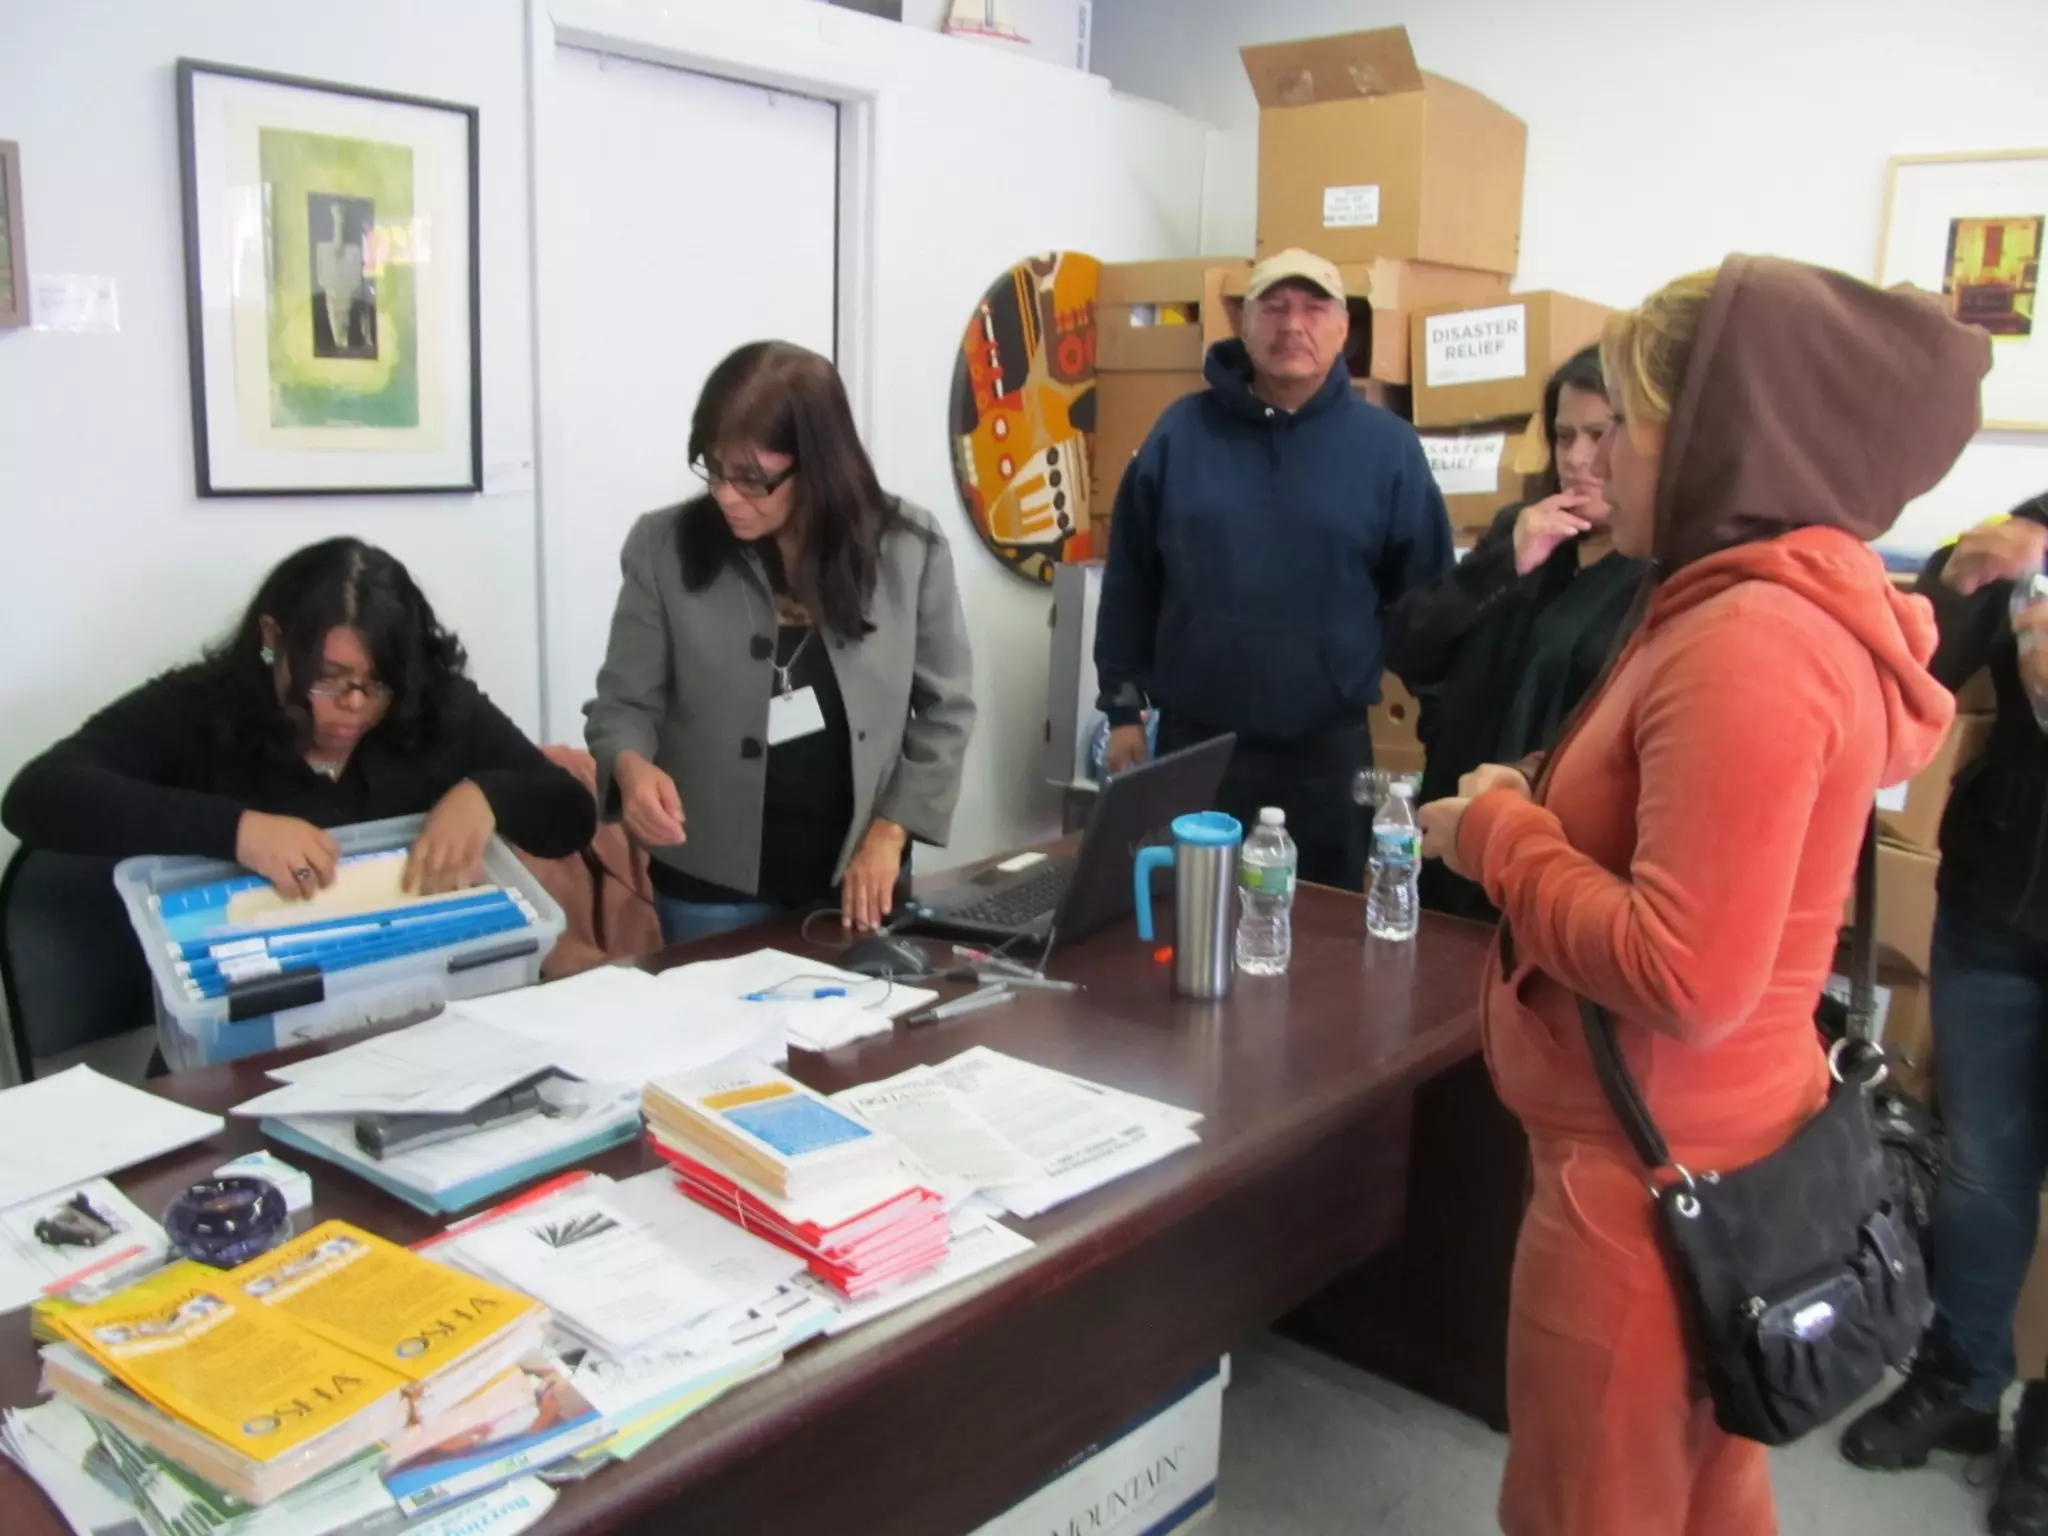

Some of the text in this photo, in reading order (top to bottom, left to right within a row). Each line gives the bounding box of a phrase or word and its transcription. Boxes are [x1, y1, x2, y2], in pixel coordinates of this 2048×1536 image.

[1432, 319, 1519, 345] DISASTER
[1444, 340, 1506, 361] RELIEF
[1428, 442, 1497, 454] SASTER
[1429, 457, 1475, 472] ELIEF
